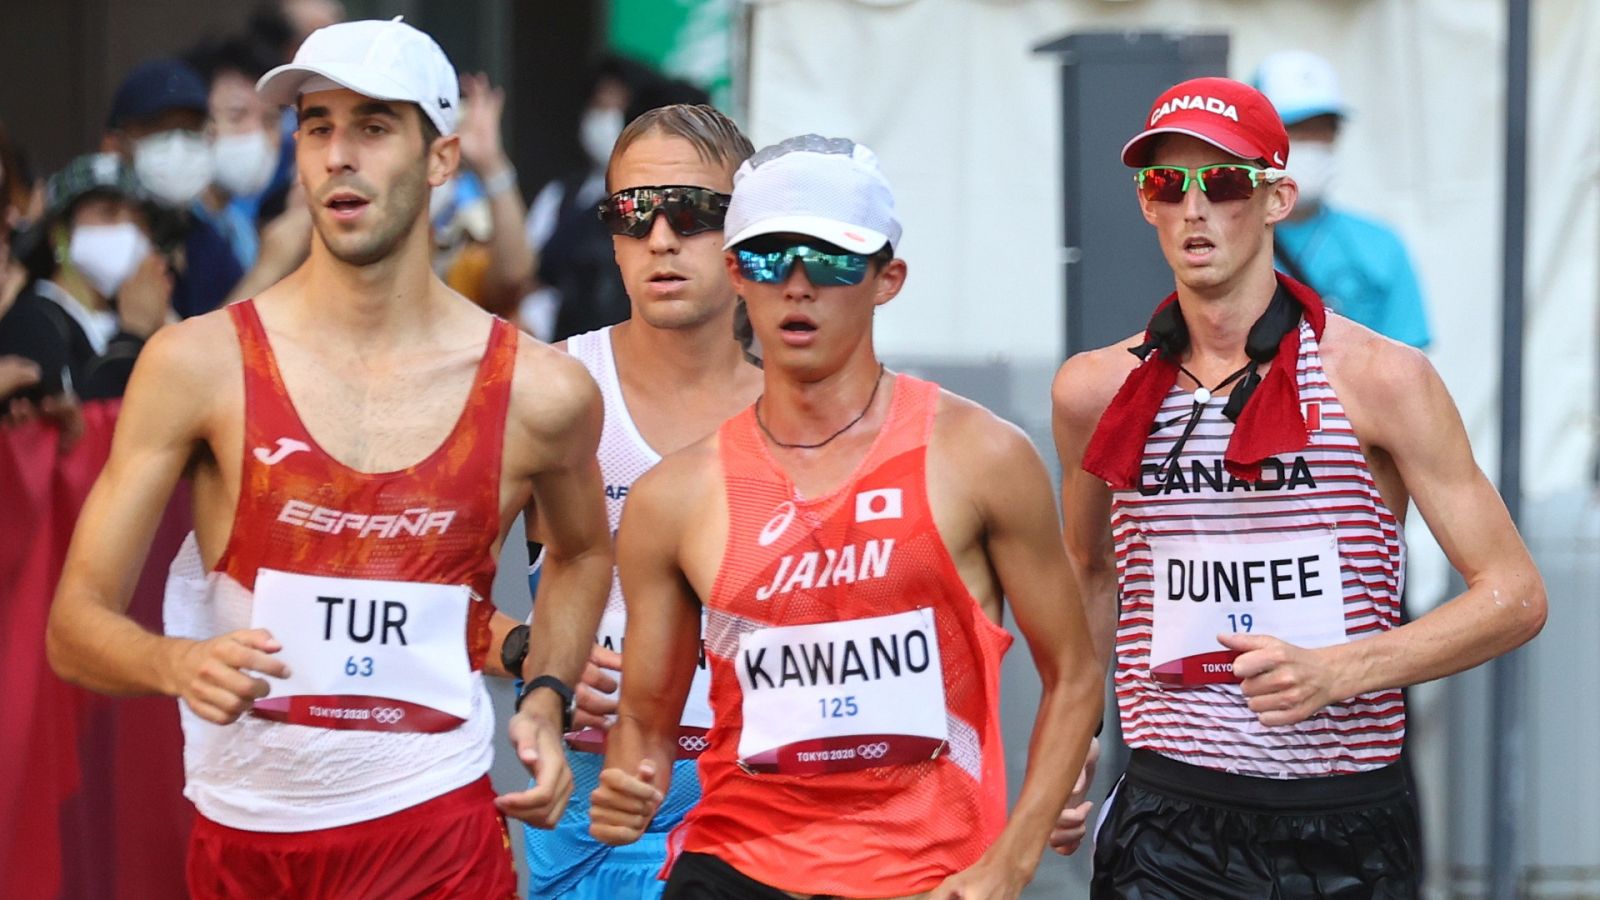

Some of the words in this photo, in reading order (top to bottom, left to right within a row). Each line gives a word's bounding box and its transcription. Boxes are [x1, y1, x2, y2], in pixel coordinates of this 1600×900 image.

[1150, 95, 1239, 127] CANADA
[276, 499, 457, 539] ESPAÑA
[1167, 554, 1323, 602] DUNFEE
[316, 596, 409, 646] TUR
[1227, 613, 1253, 633] 19
[345, 656, 374, 677] 63
[744, 629, 930, 691] KAWANO
[1201, 663, 1234, 673] TOKYO
[308, 706, 342, 719] TOKYO
[343, 708, 370, 720] 2020
[819, 696, 859, 719] 125
[796, 751, 829, 762] TOKYO
[830, 748, 856, 760] 2020
